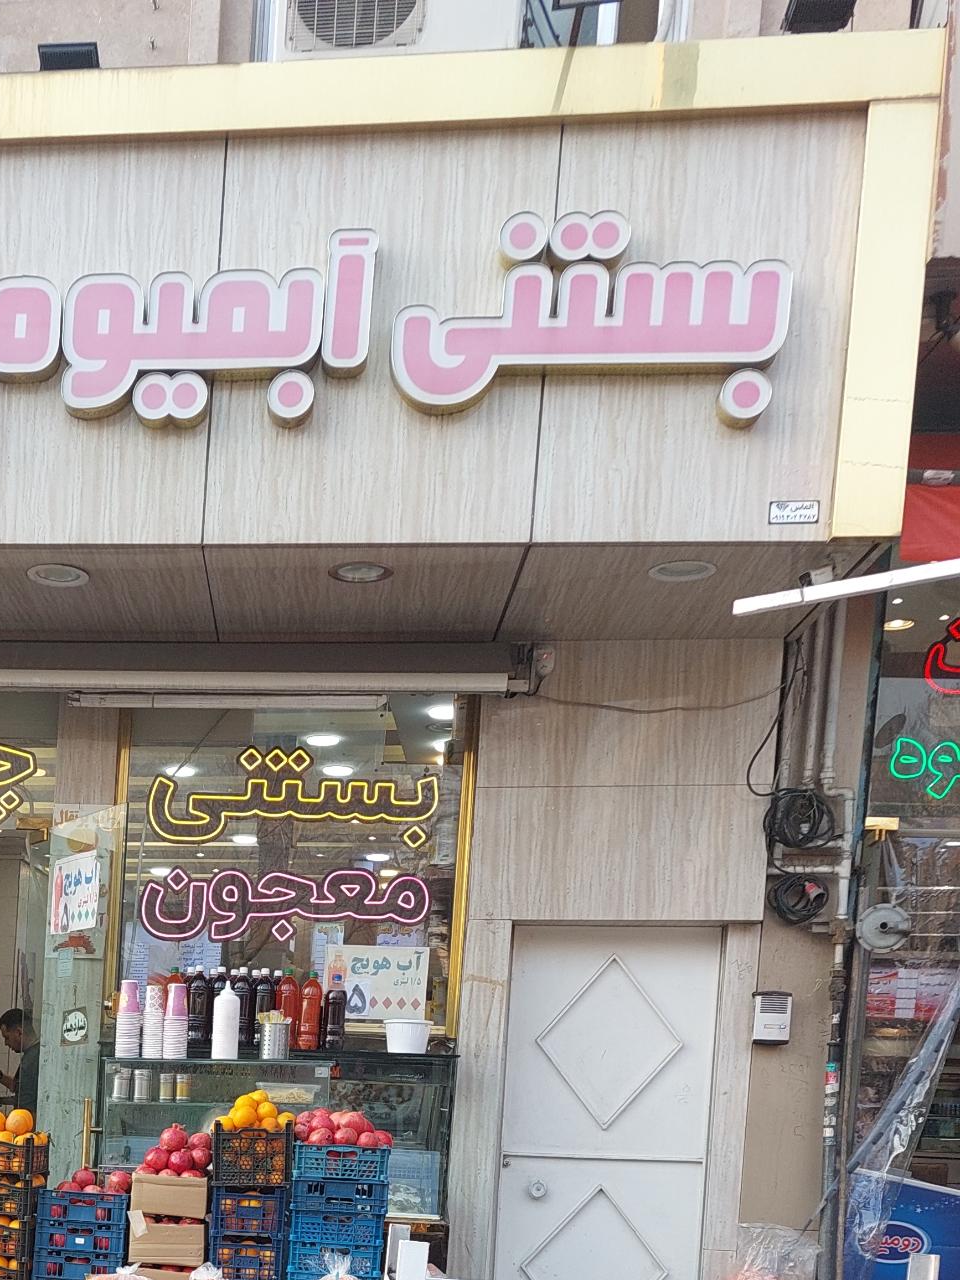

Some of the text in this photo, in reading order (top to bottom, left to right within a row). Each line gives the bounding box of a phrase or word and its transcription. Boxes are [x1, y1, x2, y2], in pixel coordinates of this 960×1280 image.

[391, 210, 792, 416] بستنی
[148, 748, 439, 848] بستنی
[141, 866, 429, 941] معجون
[351, 951, 424, 976] آب هویج
